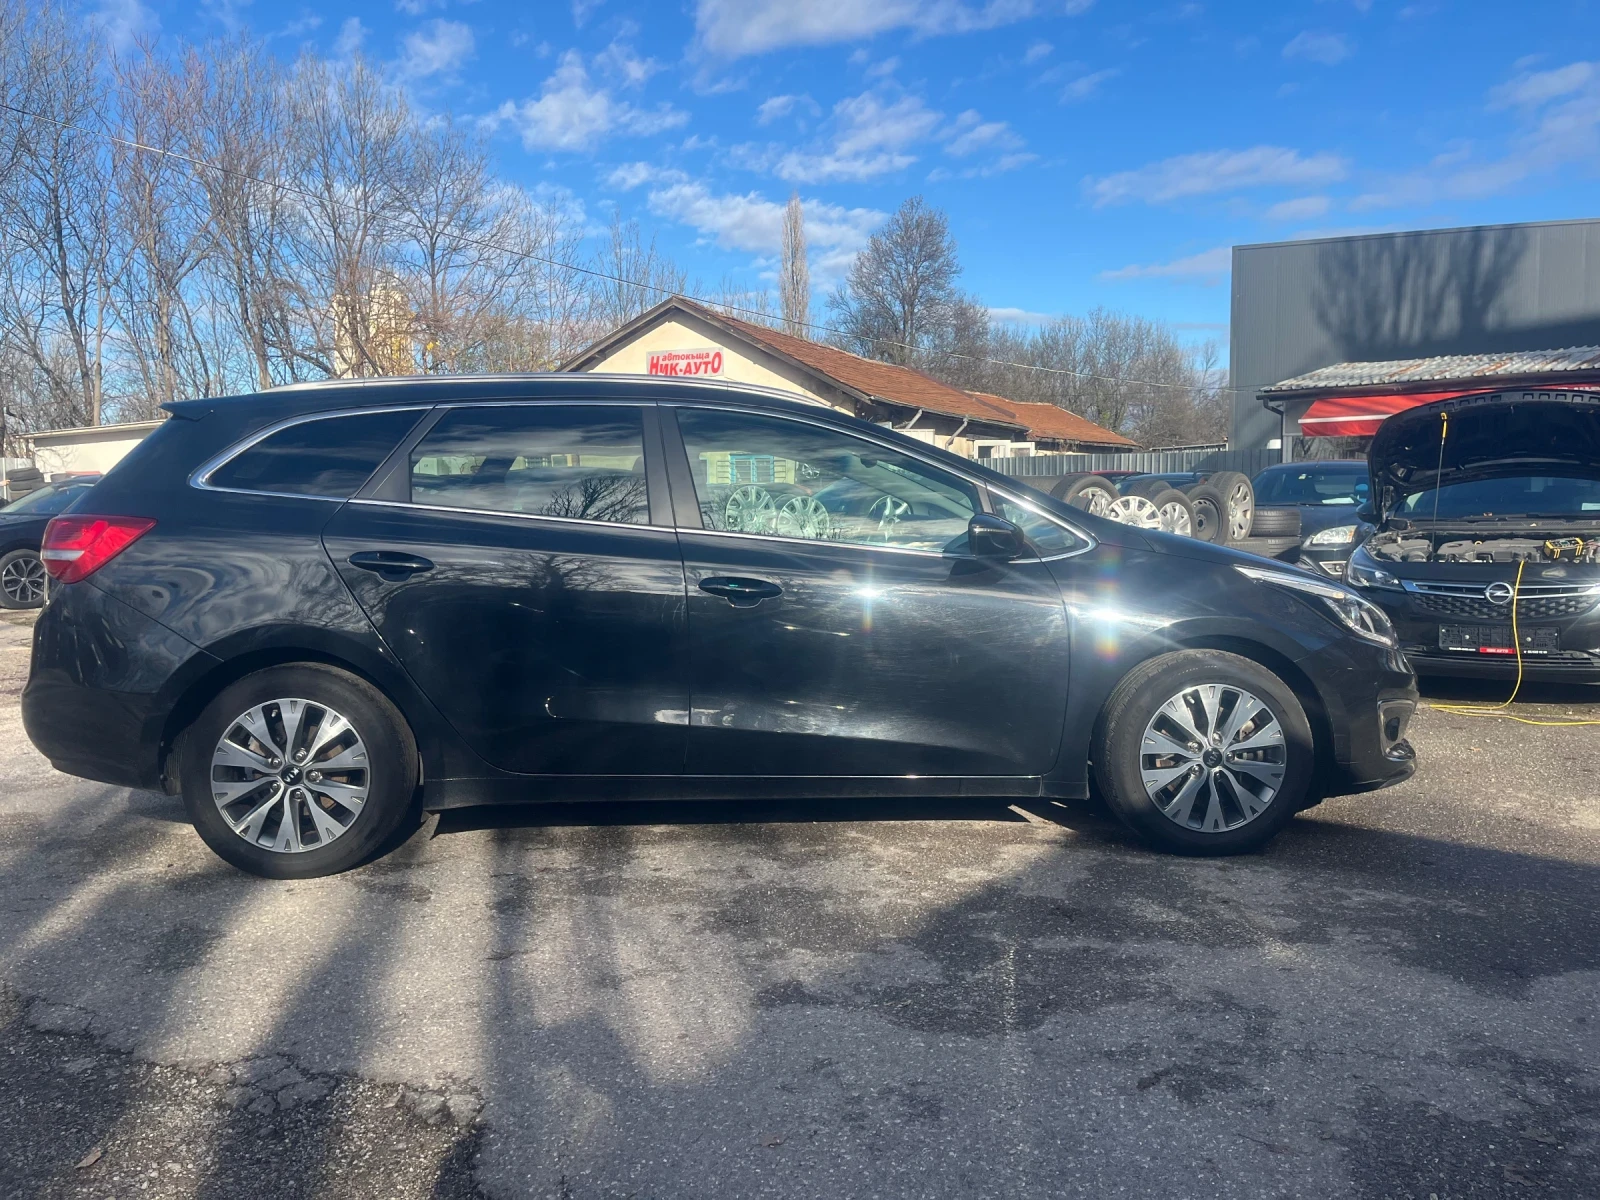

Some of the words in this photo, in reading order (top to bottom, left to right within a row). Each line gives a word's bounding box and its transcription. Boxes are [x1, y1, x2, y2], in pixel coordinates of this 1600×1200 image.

[662, 352, 710, 362] автокъща
[1206, 751, 1219, 766] KIA
[283, 767, 300, 783] KIA
